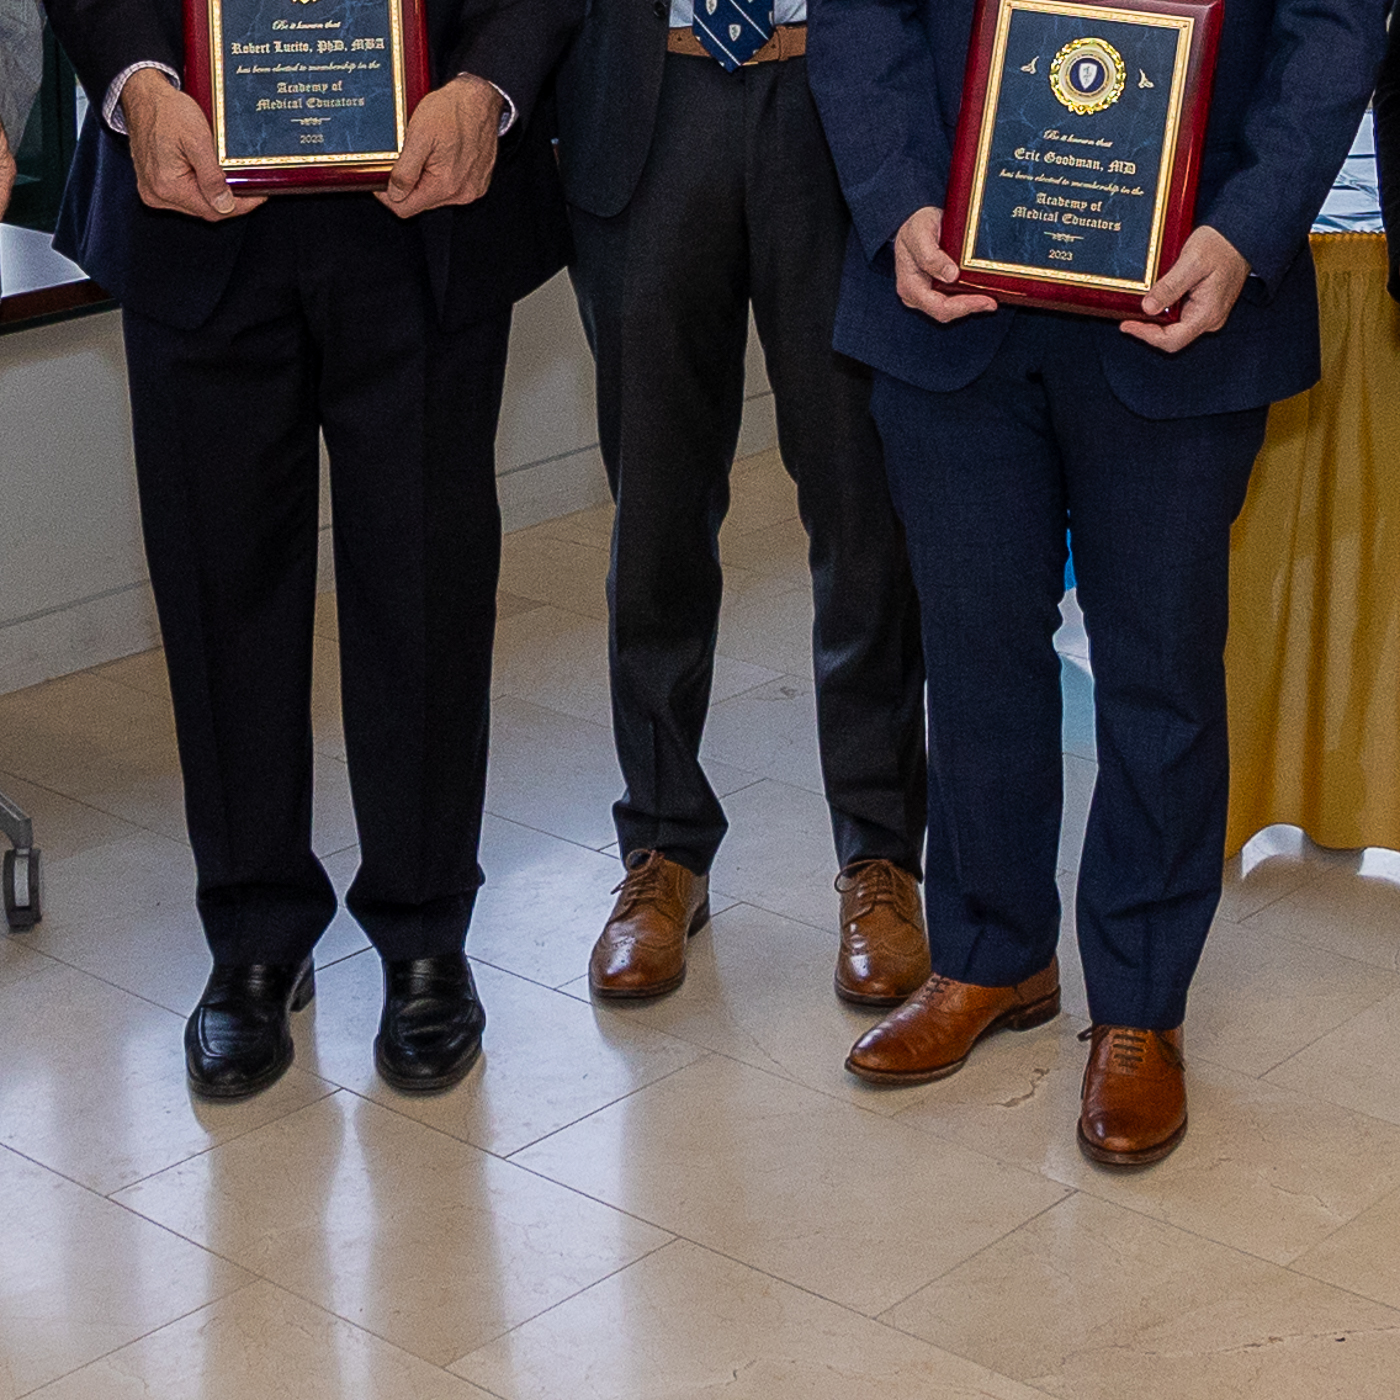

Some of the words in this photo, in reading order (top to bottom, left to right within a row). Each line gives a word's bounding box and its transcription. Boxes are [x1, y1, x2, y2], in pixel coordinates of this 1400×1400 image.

[272, 20, 289, 30] Be
[296, 21, 324, 30] known
[324, 20, 342, 28] that
[231, 42, 270, 54] Robert
[273, 40, 313, 53] Lucito,
[317, 40, 348, 54] PhD,
[351, 38, 385, 51] MBA
[236, 65, 250, 74] has
[252, 65, 270, 74] been
[272, 62, 300, 72] elected
[308, 62, 356, 74] membership
[368, 60, 381, 69] the
[276, 82, 328, 94] Academy
[332, 80, 343, 92] of
[256, 98, 303, 112] Medical
[306, 97, 365, 108] Educators
[300, 134, 324, 144] 2023
[1044, 130, 1060, 140] Be
[1066, 134, 1095, 146] known
[1096, 138, 1114, 148] that
[1014, 148, 1040, 162] Eric
[1044, 151, 1104, 172] Goodman,
[1108, 160, 1136, 175] MD
[999, 168, 1014, 178] has
[1014, 170, 1034, 181] been
[1034, 174, 1064, 185] elected
[1070, 181, 1120, 196] membership
[1131, 186, 1144, 196] the
[1036, 192, 1088, 212] Academy
[1090, 200, 1102, 212] of
[1010, 206, 1060, 222] Medical
[1062, 213, 1122, 231] Educators
[1048, 249, 1074, 260] 2023
